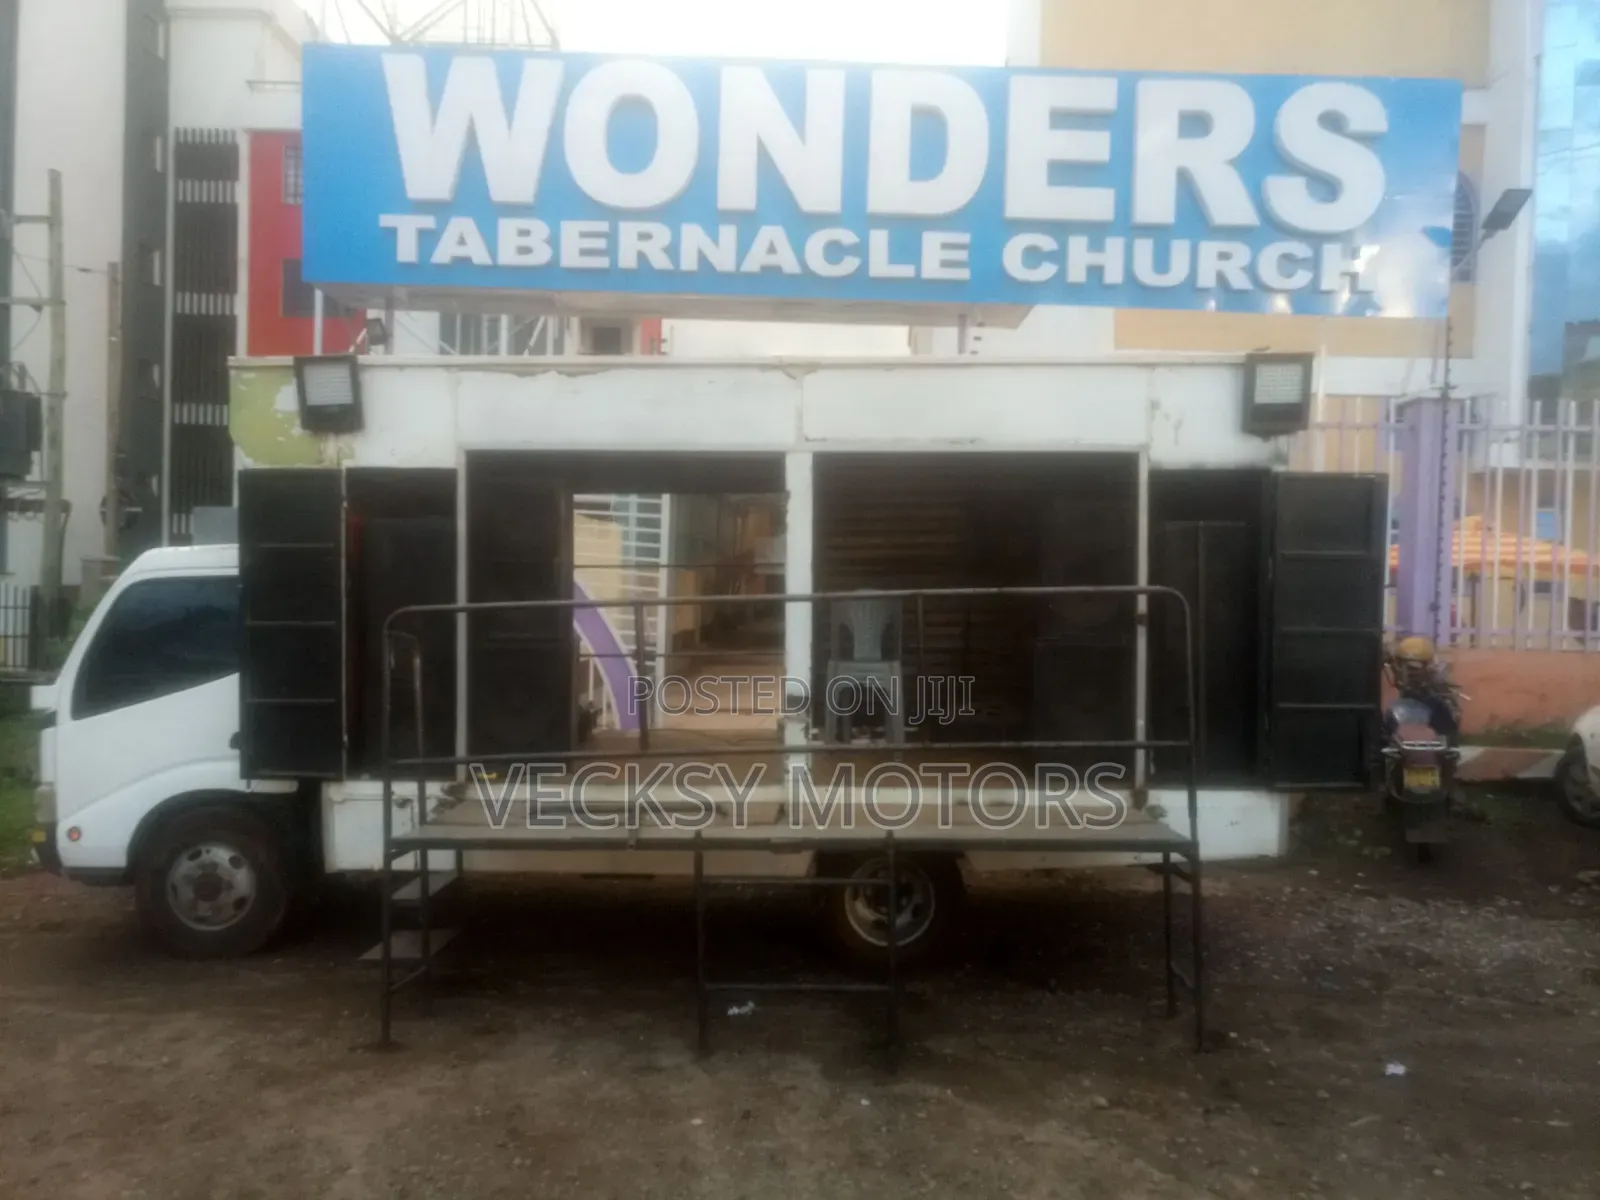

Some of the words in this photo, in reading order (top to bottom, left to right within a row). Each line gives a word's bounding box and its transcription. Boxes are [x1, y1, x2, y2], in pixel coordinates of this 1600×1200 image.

[381, 52, 1388, 234] WONDERS
[379, 214, 971, 281] TABERNACLE
[1002, 232, 1379, 293] CHURCH
